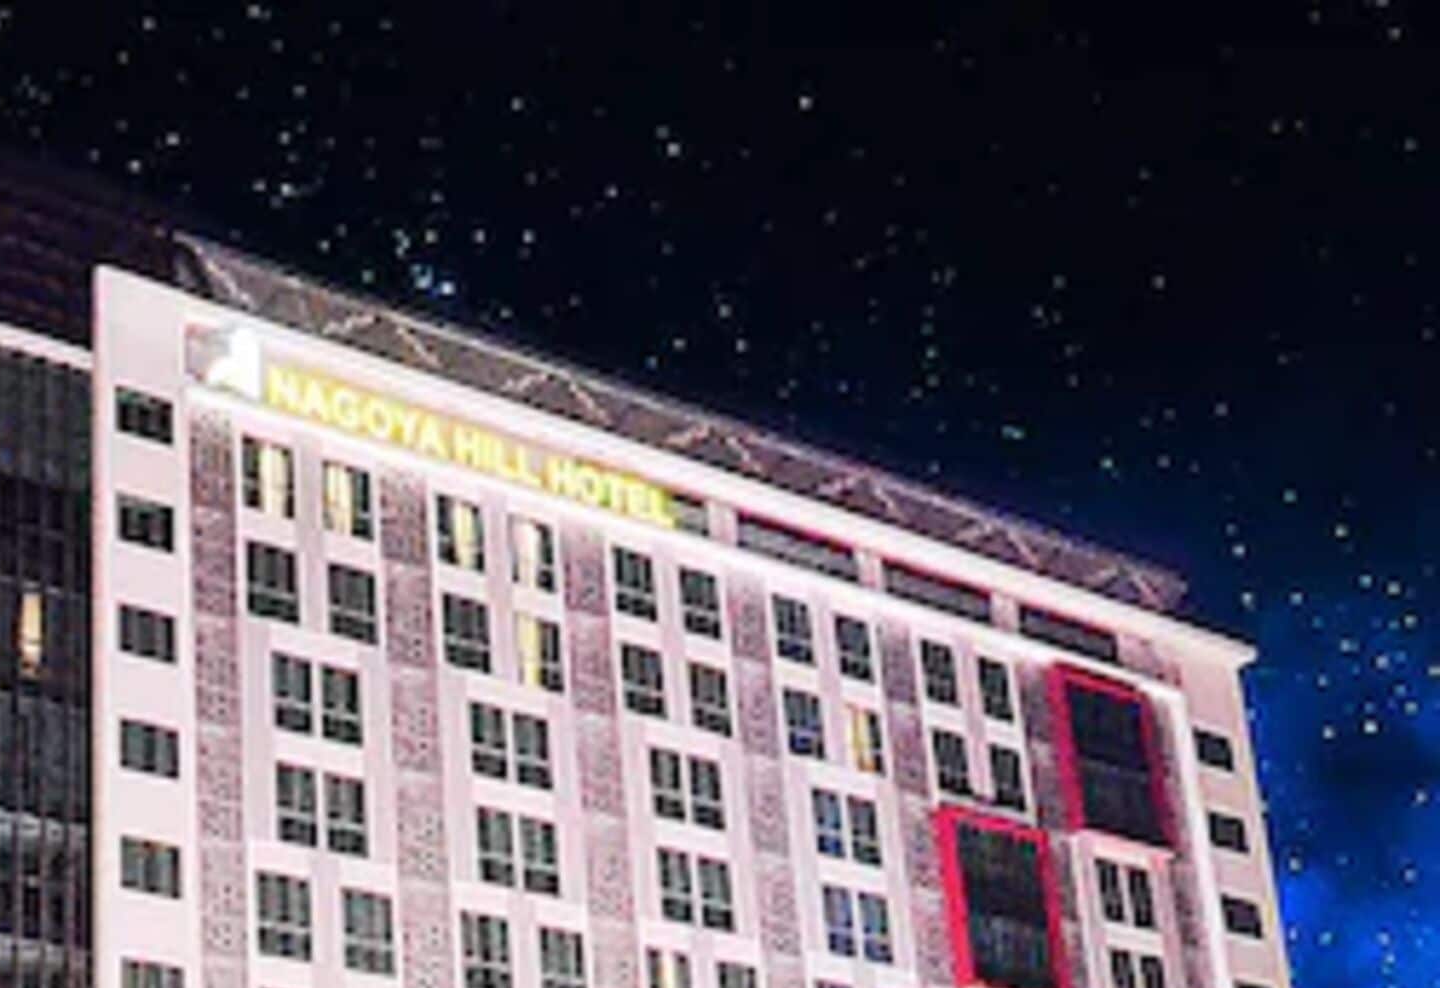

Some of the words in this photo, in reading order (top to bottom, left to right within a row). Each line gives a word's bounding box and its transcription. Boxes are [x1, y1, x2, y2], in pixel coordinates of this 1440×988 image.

[267, 367, 445, 457] NAGOYA
[452, 424, 543, 486] HILL
[549, 456, 677, 530] HOTEL
